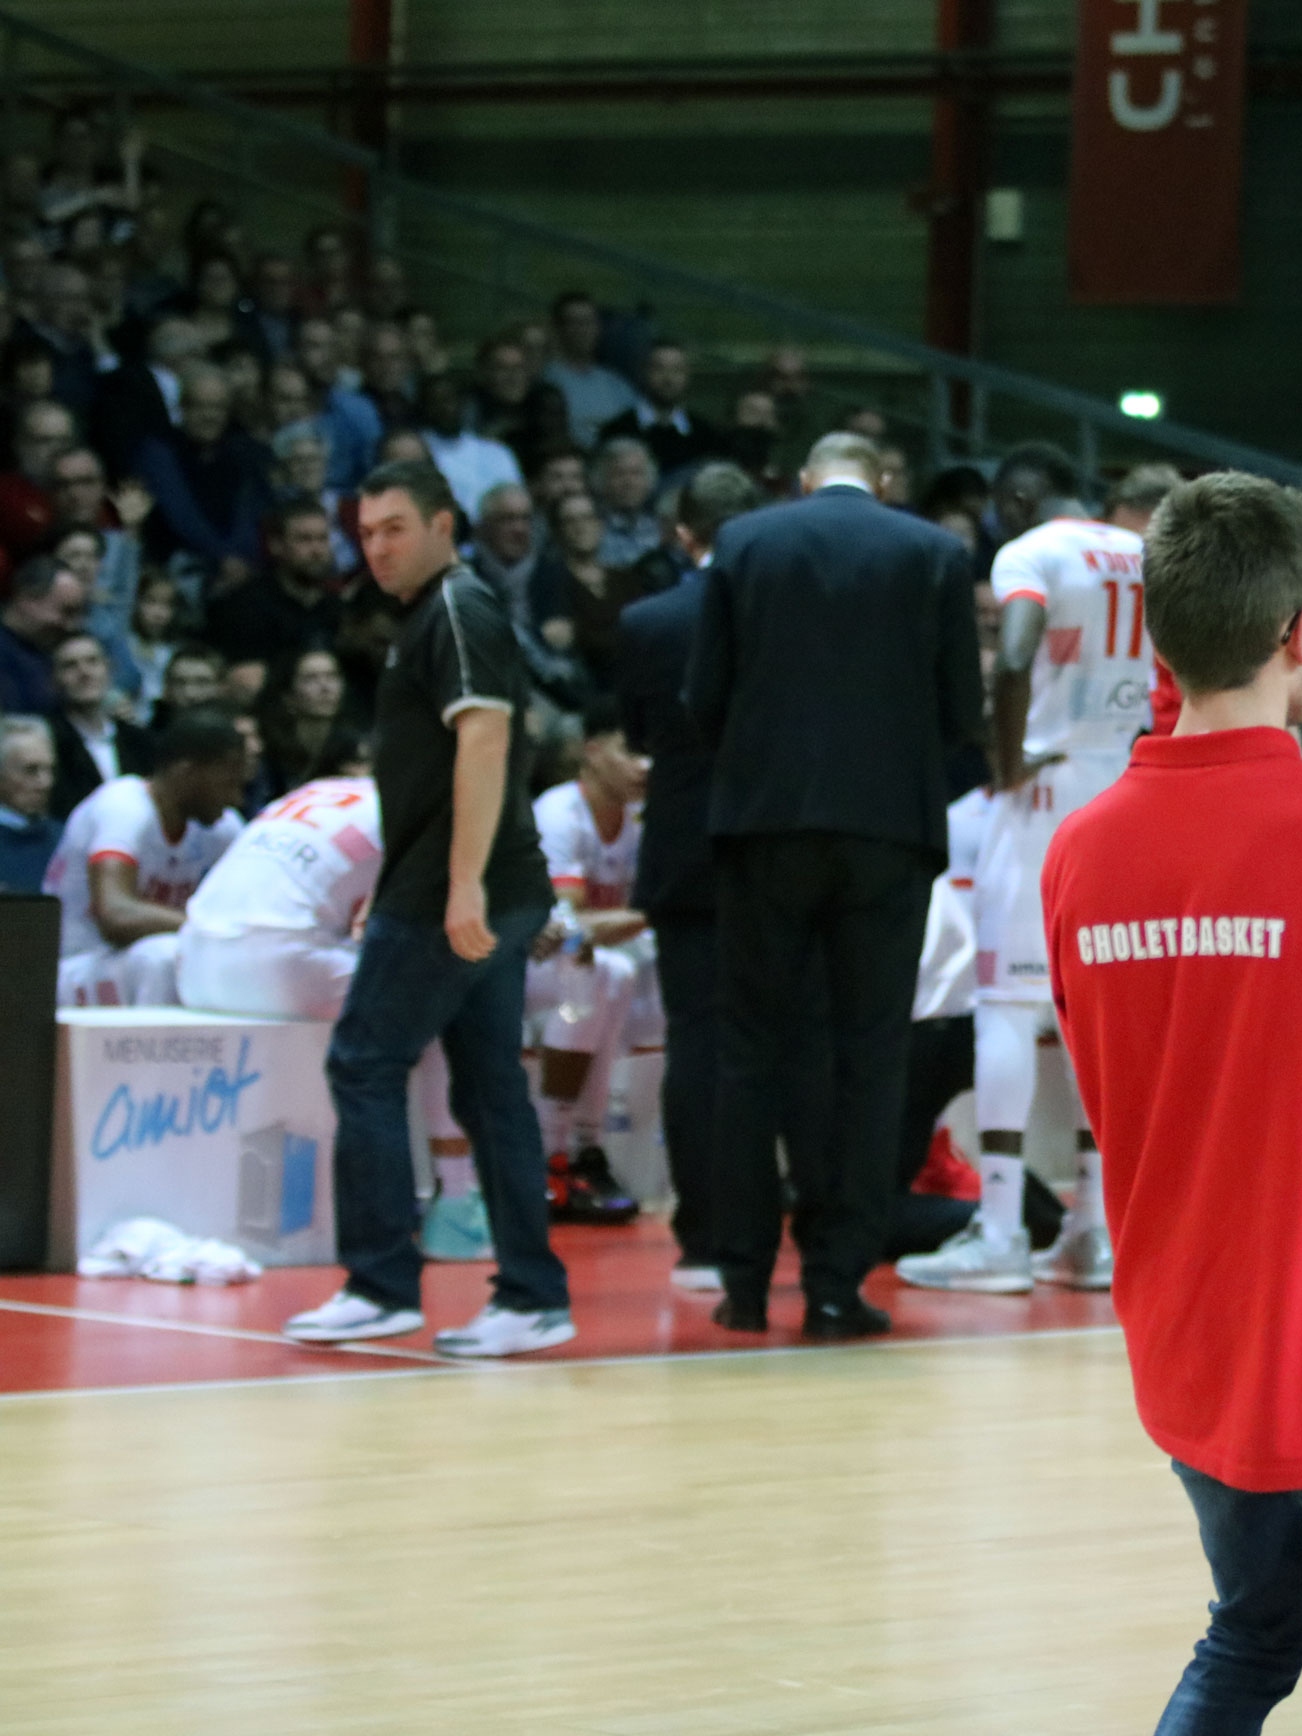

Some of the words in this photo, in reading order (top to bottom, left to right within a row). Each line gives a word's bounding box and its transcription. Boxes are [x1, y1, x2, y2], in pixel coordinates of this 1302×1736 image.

[1101, 580, 1145, 660] 11
[1077, 917, 1179, 966] CHOLET
[1180, 915, 1286, 959] BASKET
[92, 1034, 262, 1161] amiot
